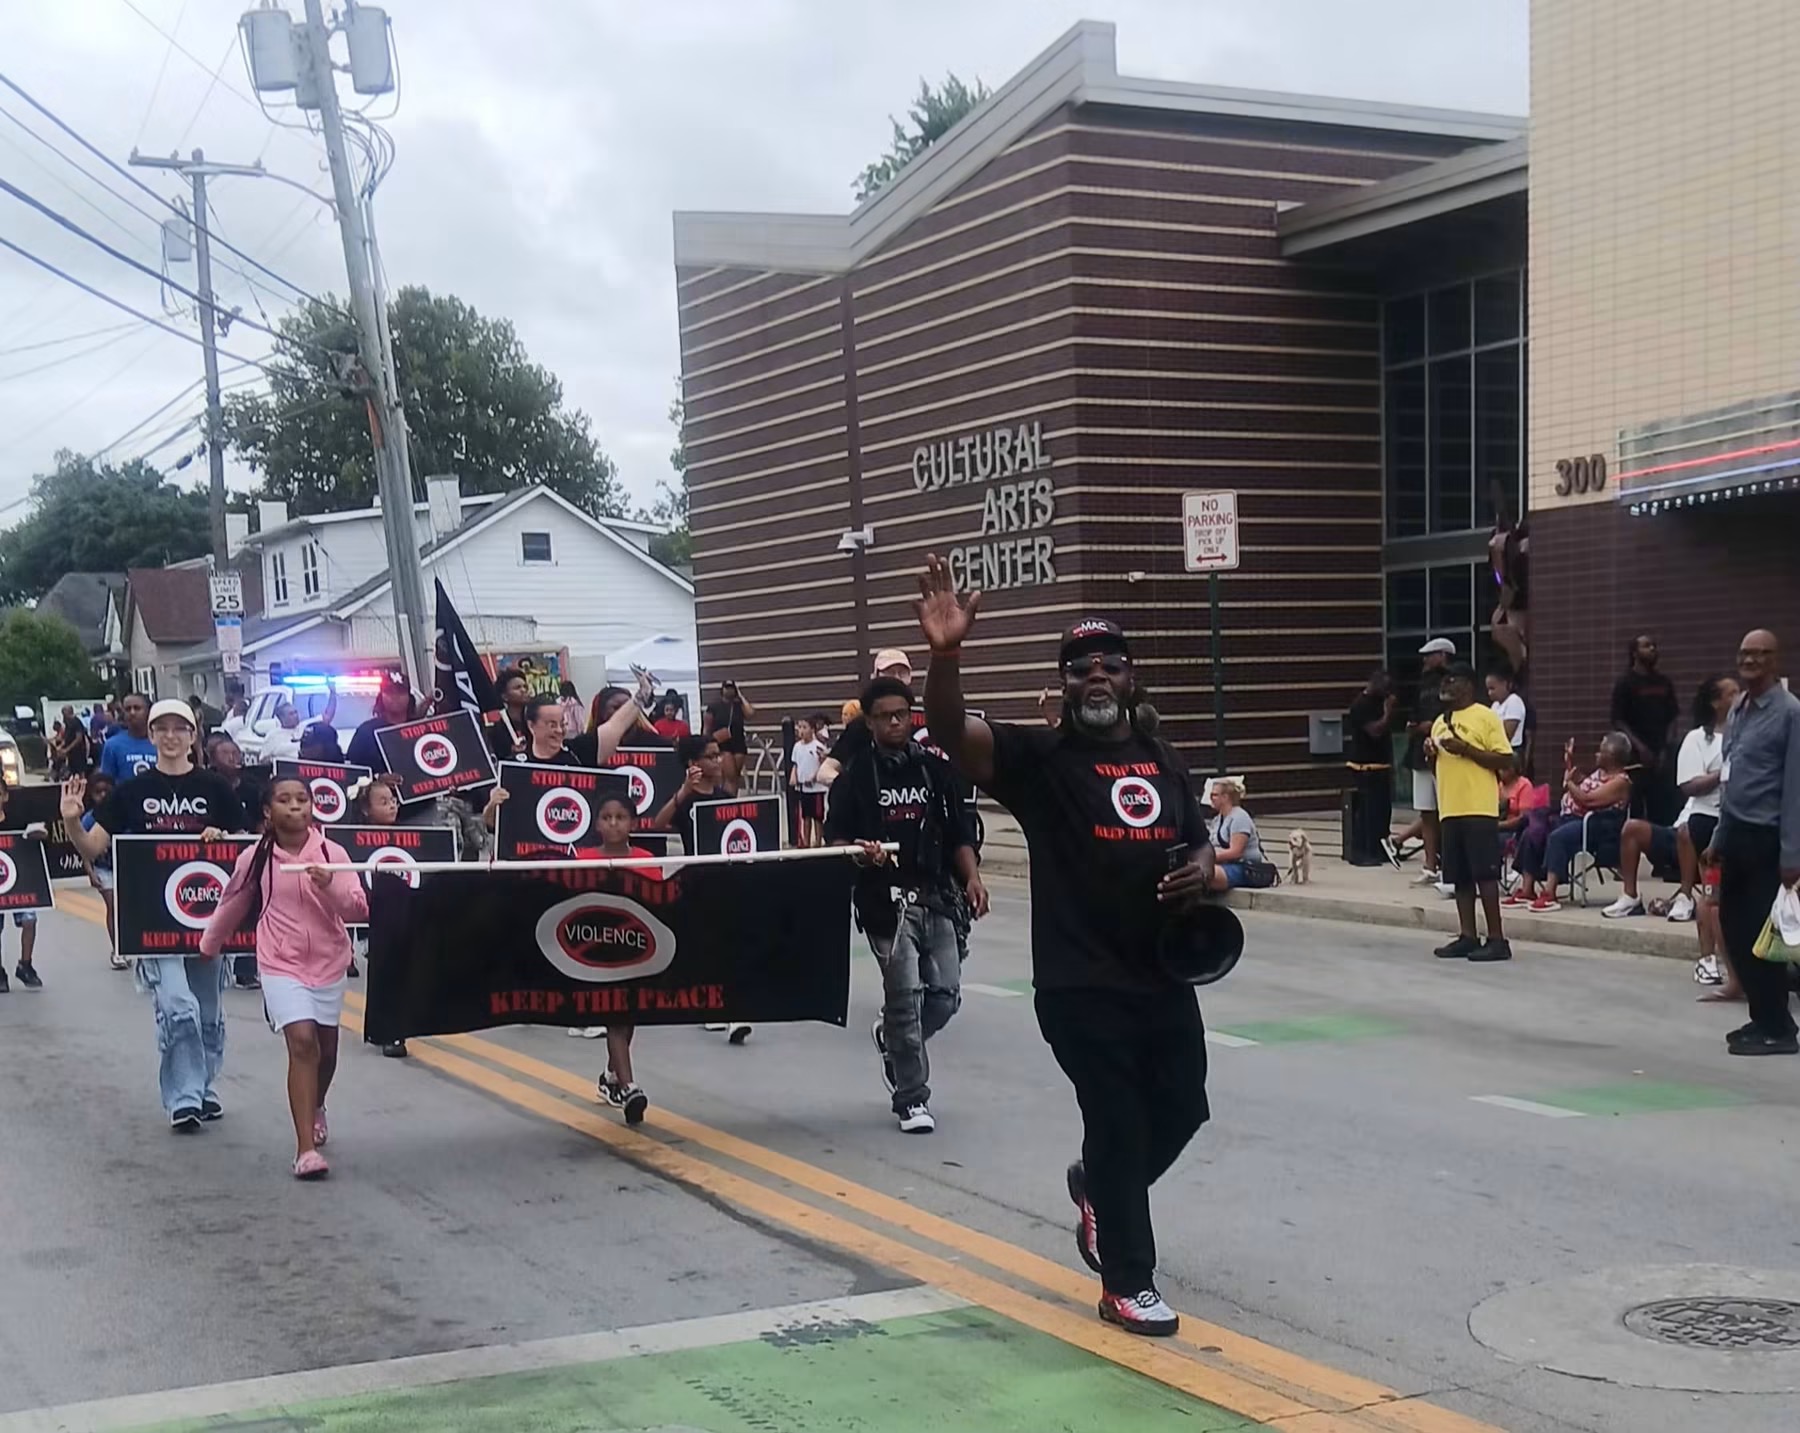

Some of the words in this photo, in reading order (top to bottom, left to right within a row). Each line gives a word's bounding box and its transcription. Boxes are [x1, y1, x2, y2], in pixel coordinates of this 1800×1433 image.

[912, 420, 1052, 493] CULTURAL
[1555, 453, 1607, 497] 300
[981, 477, 1056, 536] ARTS
[1201, 498, 1219, 512] NO
[1187, 512, 1233, 528] PARKING
[949, 535, 1057, 595] CENTER
[216, 594, 240, 610] 25
[401, 724, 427, 739] STOP
[426, 719, 449, 733] THE
[607, 753, 630, 765] TOP
[632, 752, 656, 766] THE
[299, 765, 325, 778] STOP
[326, 768, 347, 779] THE
[1095, 763, 1130, 777] STOP
[1131, 762, 1160, 775] THE
[412, 780, 436, 794] KEEP
[531, 771, 566, 786] STOP
[569, 774, 597, 788] THE
[143, 797, 207, 815] OMAC
[716, 806, 740, 820] STOP
[740, 803, 758, 818] THE
[547, 808, 579, 823] VIOLENCE
[356, 831, 393, 847] STOP
[395, 831, 421, 847] THE
[1094, 824, 1126, 840] KEEP
[1127, 827, 1152, 840] THE
[156, 843, 200, 861] STOP
[179, 886, 222, 903] VIOLENCE
[142, 931, 181, 948] KEEP
[564, 922, 648, 951] VIOLENCE
[490, 990, 564, 1015] KEEP
[572, 987, 629, 1015] THE
[638, 984, 725, 1011] PEACE
